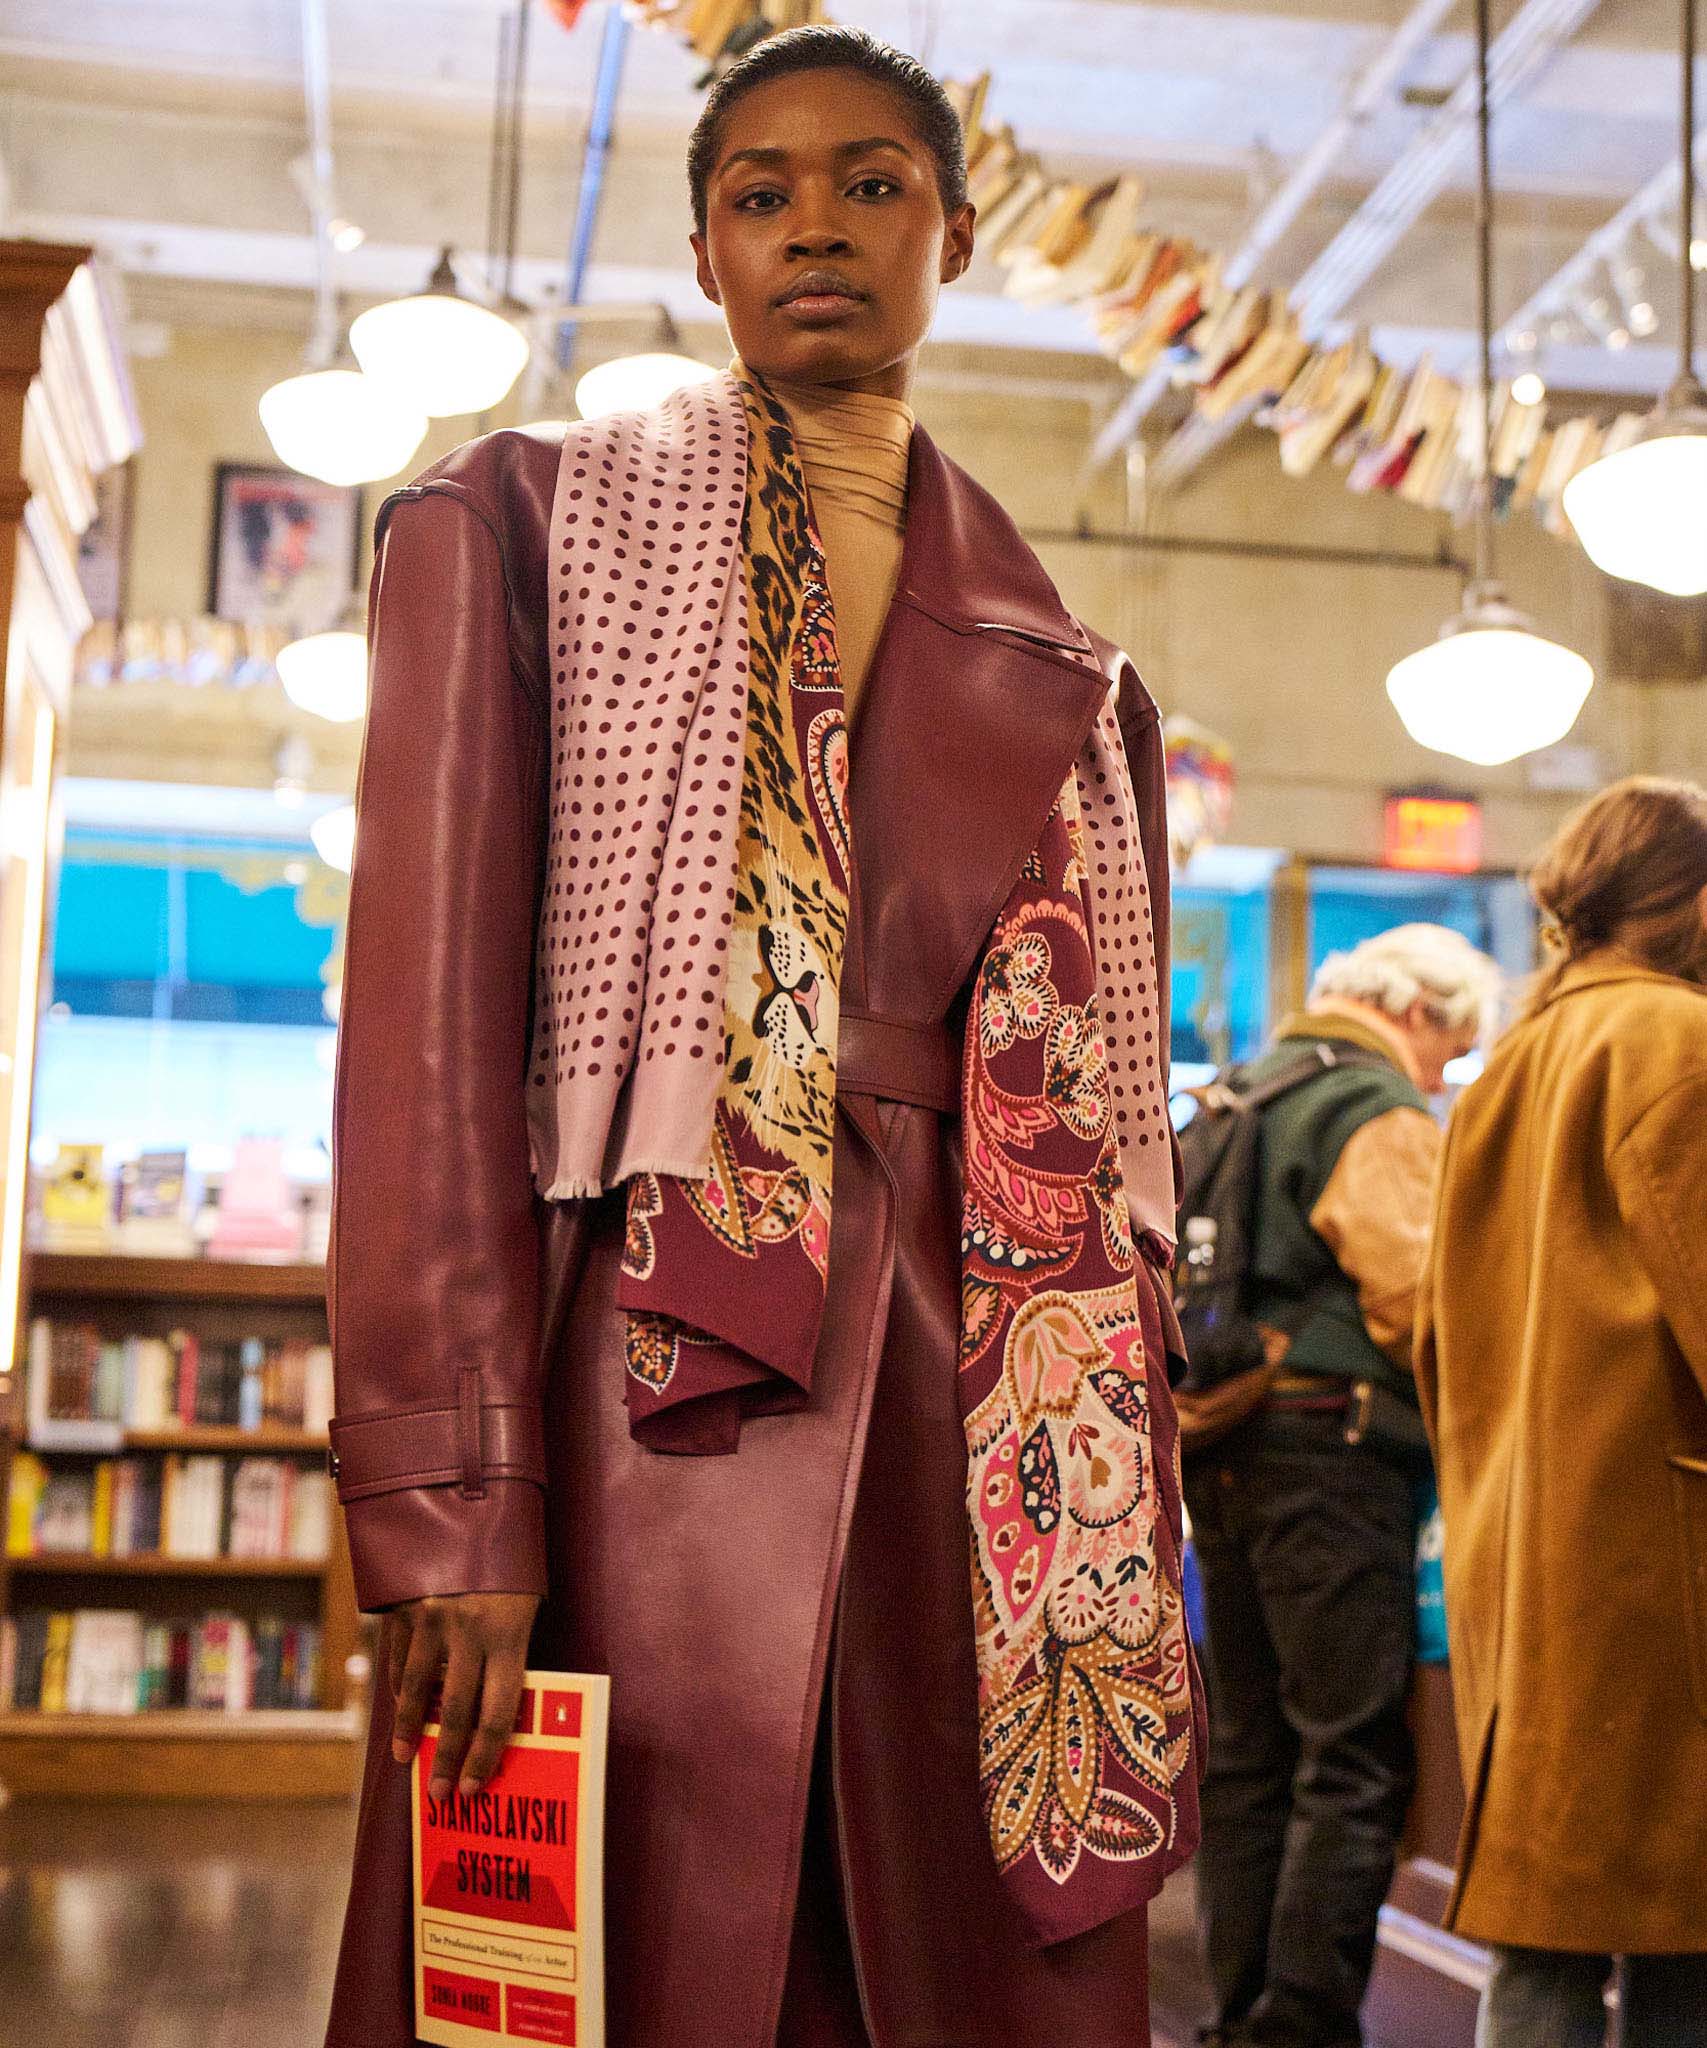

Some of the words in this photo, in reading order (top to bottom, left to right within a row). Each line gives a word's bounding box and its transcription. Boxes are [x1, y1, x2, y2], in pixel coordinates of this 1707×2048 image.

[428, 1791, 567, 1845] STANISLAVSKI
[457, 1850, 531, 1903] SYSTEM
[429, 1932, 442, 1944] The
[443, 1935, 489, 1954] Professional
[490, 1946, 523, 1962] Training
[545, 1955, 568, 1967] Actor
